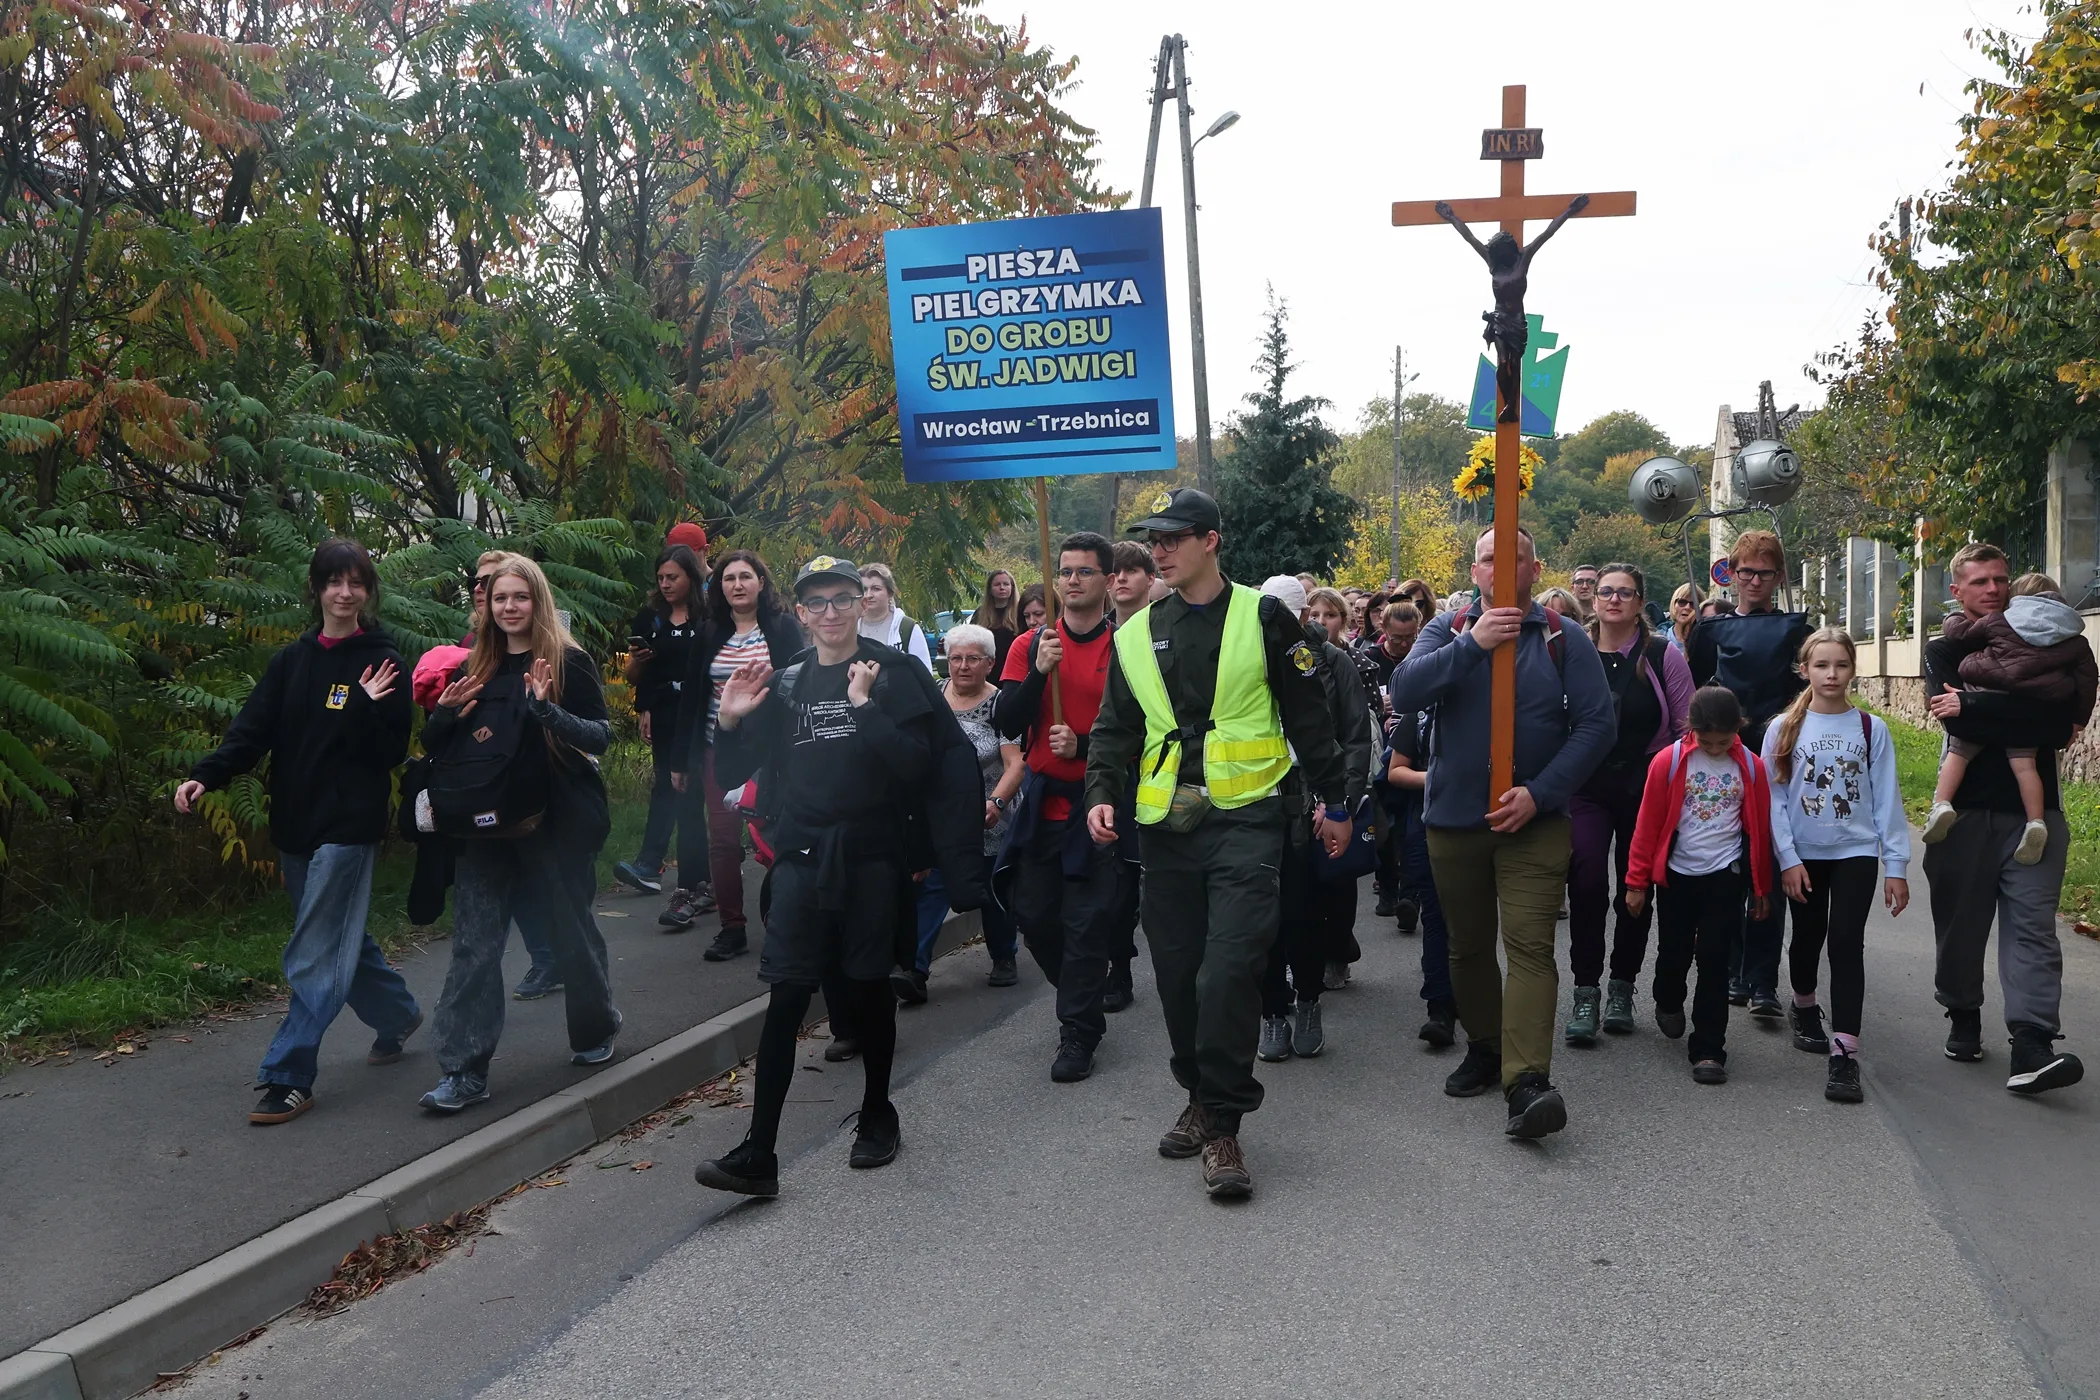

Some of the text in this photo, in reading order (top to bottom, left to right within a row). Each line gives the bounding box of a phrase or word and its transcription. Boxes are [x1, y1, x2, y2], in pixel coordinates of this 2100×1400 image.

[967, 248, 1081, 282] PIESZA
[913, 279, 1143, 321] PIELGRZYMKA
[947, 317, 1112, 354] DO GROBU
[928, 351, 1136, 390] ŚW. JADWIGI
[1530, 373, 1551, 388] 21
[1810, 739, 1843, 752] BEST
[476, 815, 495, 825] FILA
